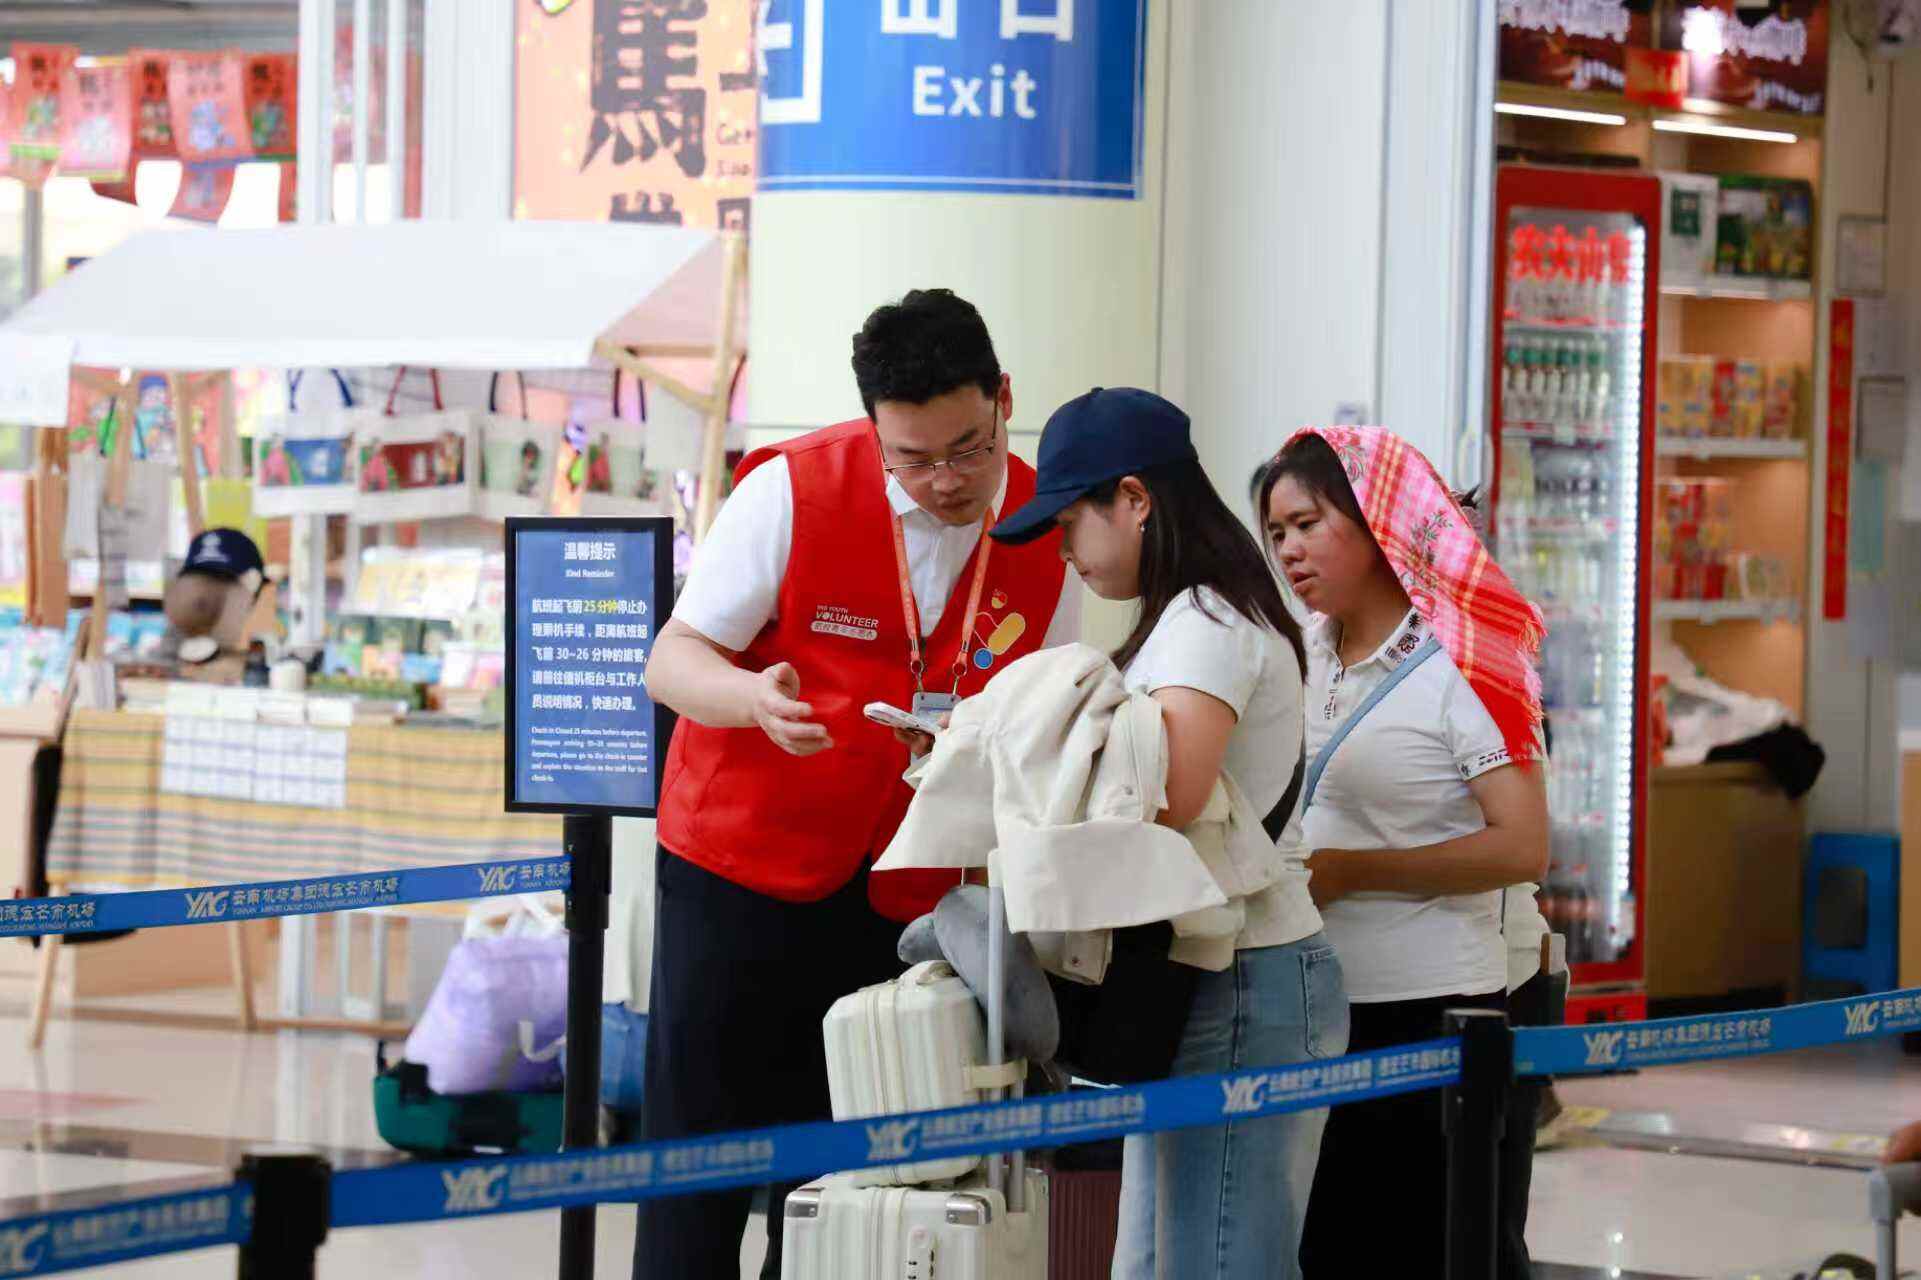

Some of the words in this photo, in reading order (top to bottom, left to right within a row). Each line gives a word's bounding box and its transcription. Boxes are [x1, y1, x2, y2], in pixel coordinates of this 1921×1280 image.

[912, 63, 1037, 119] Exit
[564, 542, 617, 560] 温馨提示
[815, 610, 880, 629] VOLUNTEER
[184, 891, 230, 919] YAC
[1221, 1074, 1269, 1114] YAC
[866, 1117, 920, 1161] YAC
[441, 1163, 507, 1213] YAC
